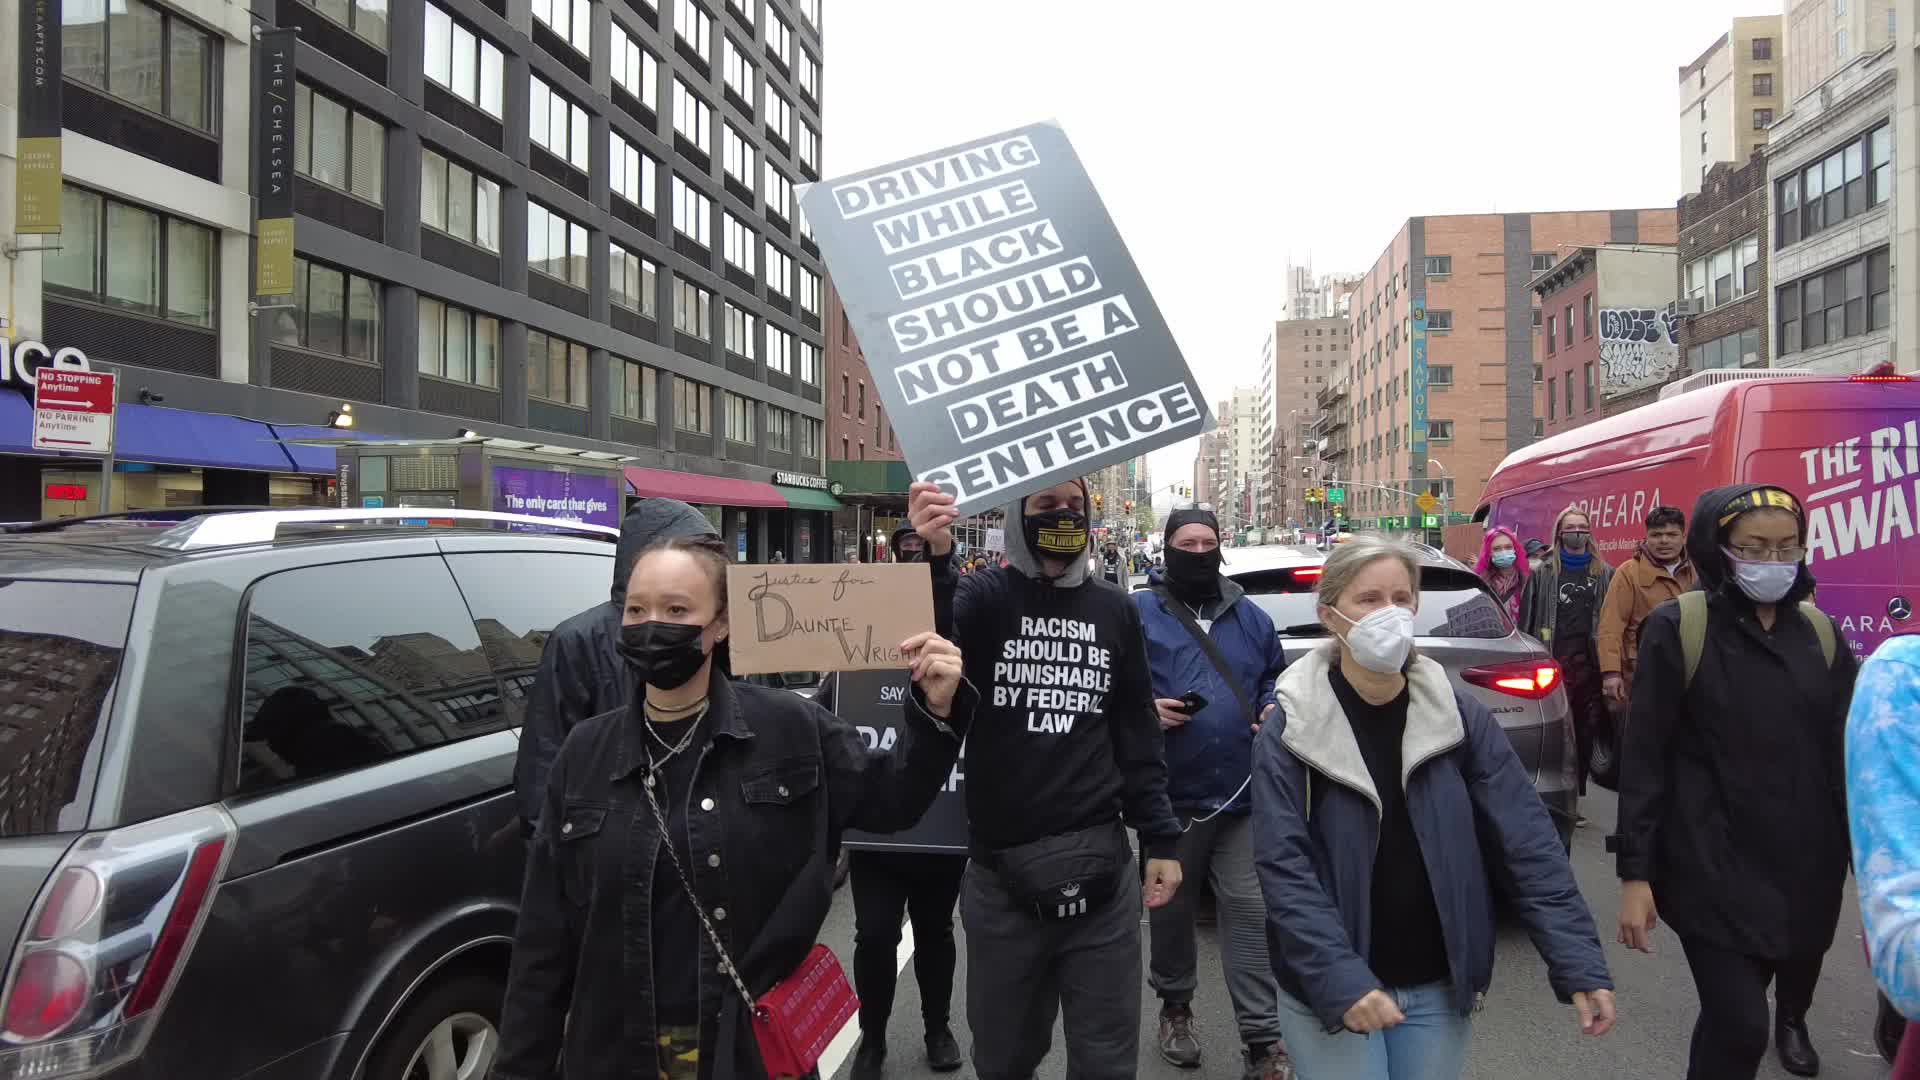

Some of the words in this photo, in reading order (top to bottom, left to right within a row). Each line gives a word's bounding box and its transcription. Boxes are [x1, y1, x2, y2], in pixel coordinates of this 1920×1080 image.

[835, 139, 1037, 215] DRIVING
[875, 182, 1035, 249] WHILE
[891, 222, 1062, 297] BLACK
[894, 261, 1096, 346] SHOULD
[897, 339, 1000, 403] NOT
[1016, 314, 1088, 361] BE
[1102, 301, 1137, 337] A
[41, 372, 55, 381] NO
[56, 374, 102, 385] STOPPING
[41, 382, 80, 392] Anytime
[950, 355, 1126, 439] DEATH
[39, 411, 53, 420] NO
[55, 412, 95, 423] PARKING
[39, 421, 77, 431] Anytime
[922, 385, 1198, 502] SENTENCE
[1800, 436, 1862, 485] THE
[776, 471, 809, 487] STARBUCKS
[809, 476, 828, 489] COFFEE
[504, 493, 524, 509] The
[525, 495, 546, 512] only
[546, 496, 568, 511] card
[568, 497, 586, 511] that
[586, 498, 608, 514] gives
[748, 571, 823, 601] Justice
[832, 569, 877, 601] for
[1020, 616, 1096, 642] RACISM
[1830, 615, 1894, 633] ARA
[1002, 639, 1083, 663] SHOULD
[1088, 645, 1111, 669] BE
[994, 662, 1111, 693] PUNISHABLE
[880, 686, 905, 701] SAY
[993, 686, 1022, 707] BY
[1027, 711, 1075, 734] LAW
